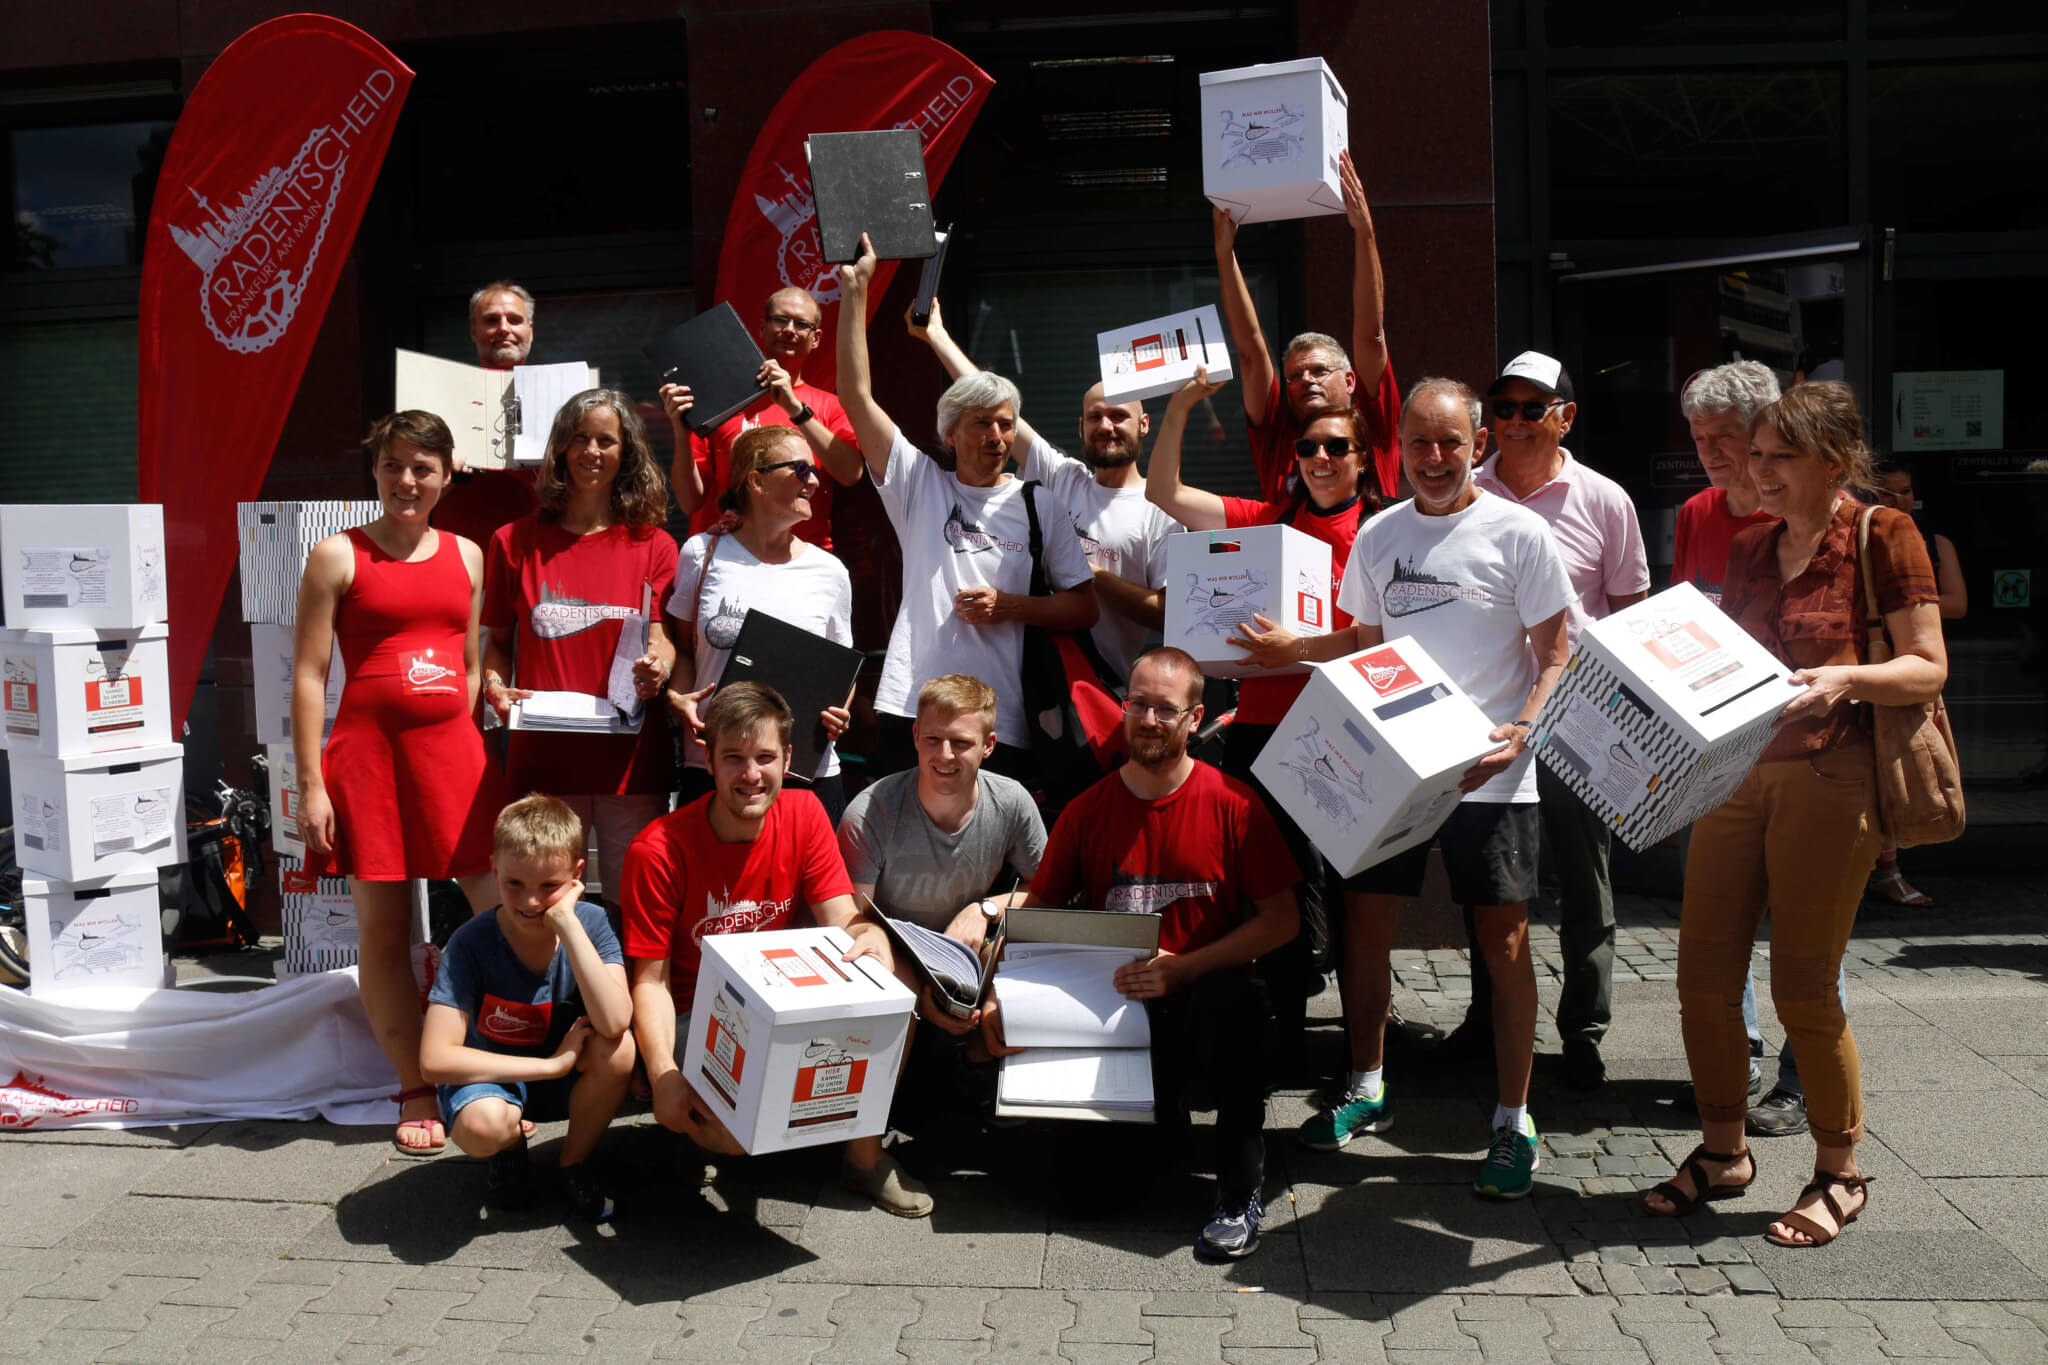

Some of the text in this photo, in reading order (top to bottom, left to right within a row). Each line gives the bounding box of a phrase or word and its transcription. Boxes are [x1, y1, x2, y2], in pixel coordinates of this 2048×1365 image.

[213, 69, 395, 307] RADENTSCHEID
[225, 202, 323, 328] FRANKFURT AM MAIN
[948, 523, 1025, 553] RADENTSCHEID
[1391, 584, 1492, 601] RADENTSCHEID
